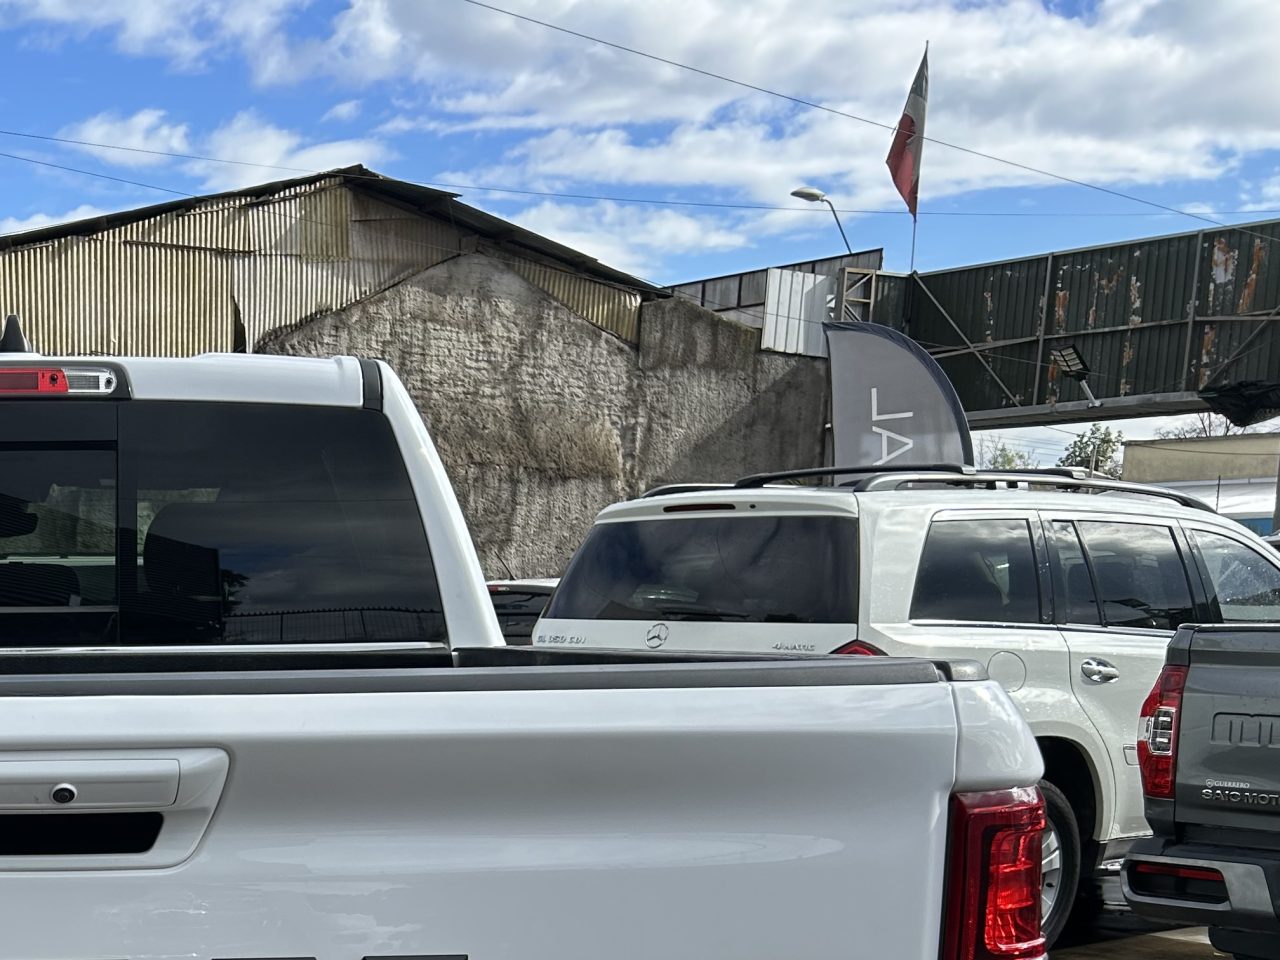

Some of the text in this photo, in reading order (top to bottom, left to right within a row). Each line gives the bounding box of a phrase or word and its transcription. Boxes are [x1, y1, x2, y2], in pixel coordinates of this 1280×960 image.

[1214, 780, 1250, 789] GUERRERO
[1201, 788, 1280, 806] SAIC MOT
